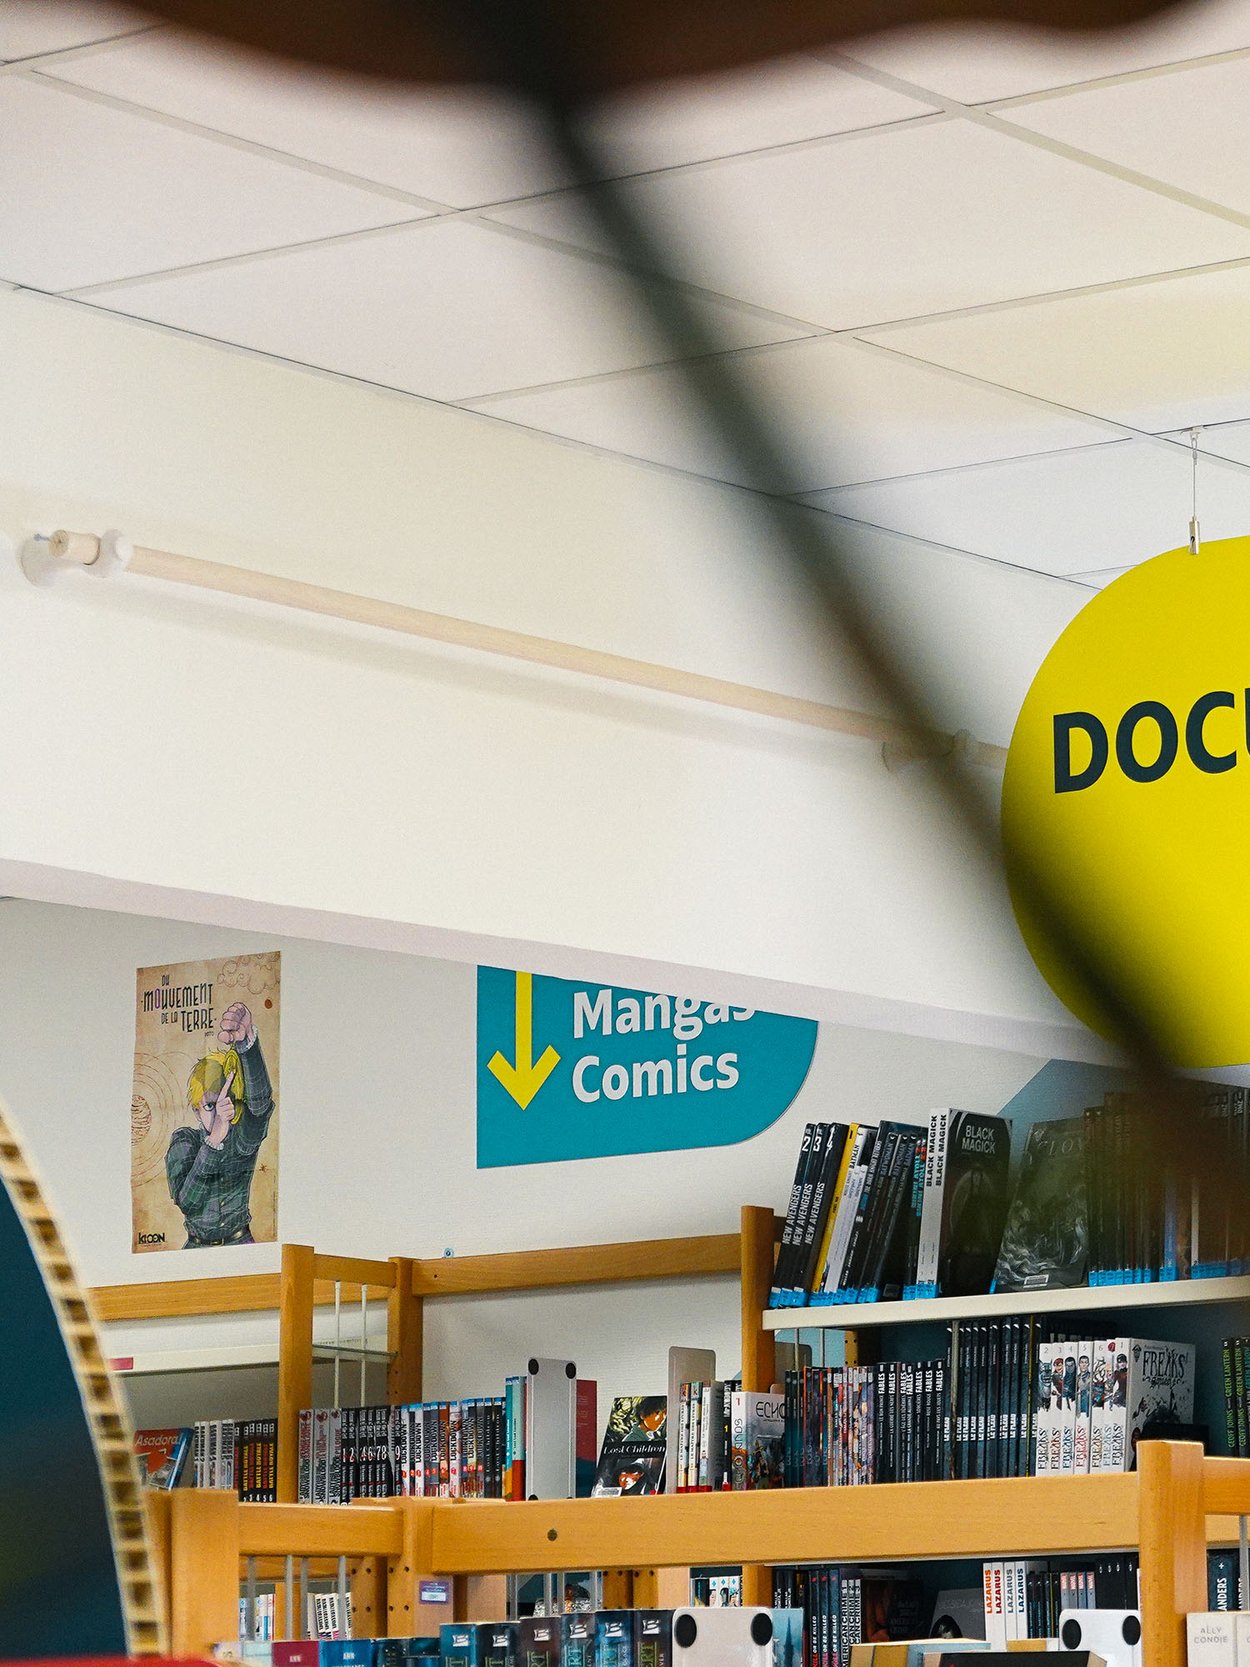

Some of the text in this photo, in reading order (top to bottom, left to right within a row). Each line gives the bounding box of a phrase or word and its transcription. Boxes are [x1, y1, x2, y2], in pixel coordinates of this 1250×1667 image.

[161, 974, 170, 987] DU
[143, 984, 214, 1012] MOUVEMENT
[181, 1008, 214, 1033] TERRE
[572, 1043, 740, 1103] Comics
[965, 1124, 995, 1141] BLACK
[802, 1135, 811, 1152] 2
[812, 1136, 821, 1152] 3
[926, 1115, 938, 1187] BLACK MAGICK
[936, 1114, 947, 1187] BLACK MAGICK
[961, 1138, 996, 1154] MAGICK
[782, 1184, 802, 1245] NEW AVENGERS
[792, 1183, 813, 1246] NEW AVENGERS
[804, 1182, 825, 1245] NEW AVENGERS
[1223, 1349, 1231, 1377] LANTERN
[1234, 1348, 1242, 1375] LANTERN
[888, 1373, 896, 1394] FABLES
[1224, 1377, 1232, 1397] GREEN
[1235, 1376, 1243, 1396] GREEN
[1226, 1409, 1234, 1428] JOHNS
[1237, 1408, 1245, 1426] JOHNS
[342, 1447, 346, 1463] 1
[349, 1447, 354, 1463] 2
[361, 1446, 367, 1461] 4
[368, 1446, 373, 1461] 6
[376, 1445, 381, 1461] 7
[381, 1445, 387, 1460] 8
[395, 1445, 400, 1460] 9
[603, 1444, 666, 1455] Lost Children
[985, 1569, 993, 1614] LAZARUS
[994, 1569, 1002, 1614] LAZARUS
[1006, 1569, 1014, 1614] LAZARUS
[1017, 1568, 1025, 1613] LAZARUS
[1194, 1635, 1228, 1644] CONDIE
[1200, 1626, 1222, 1634] ALLY
